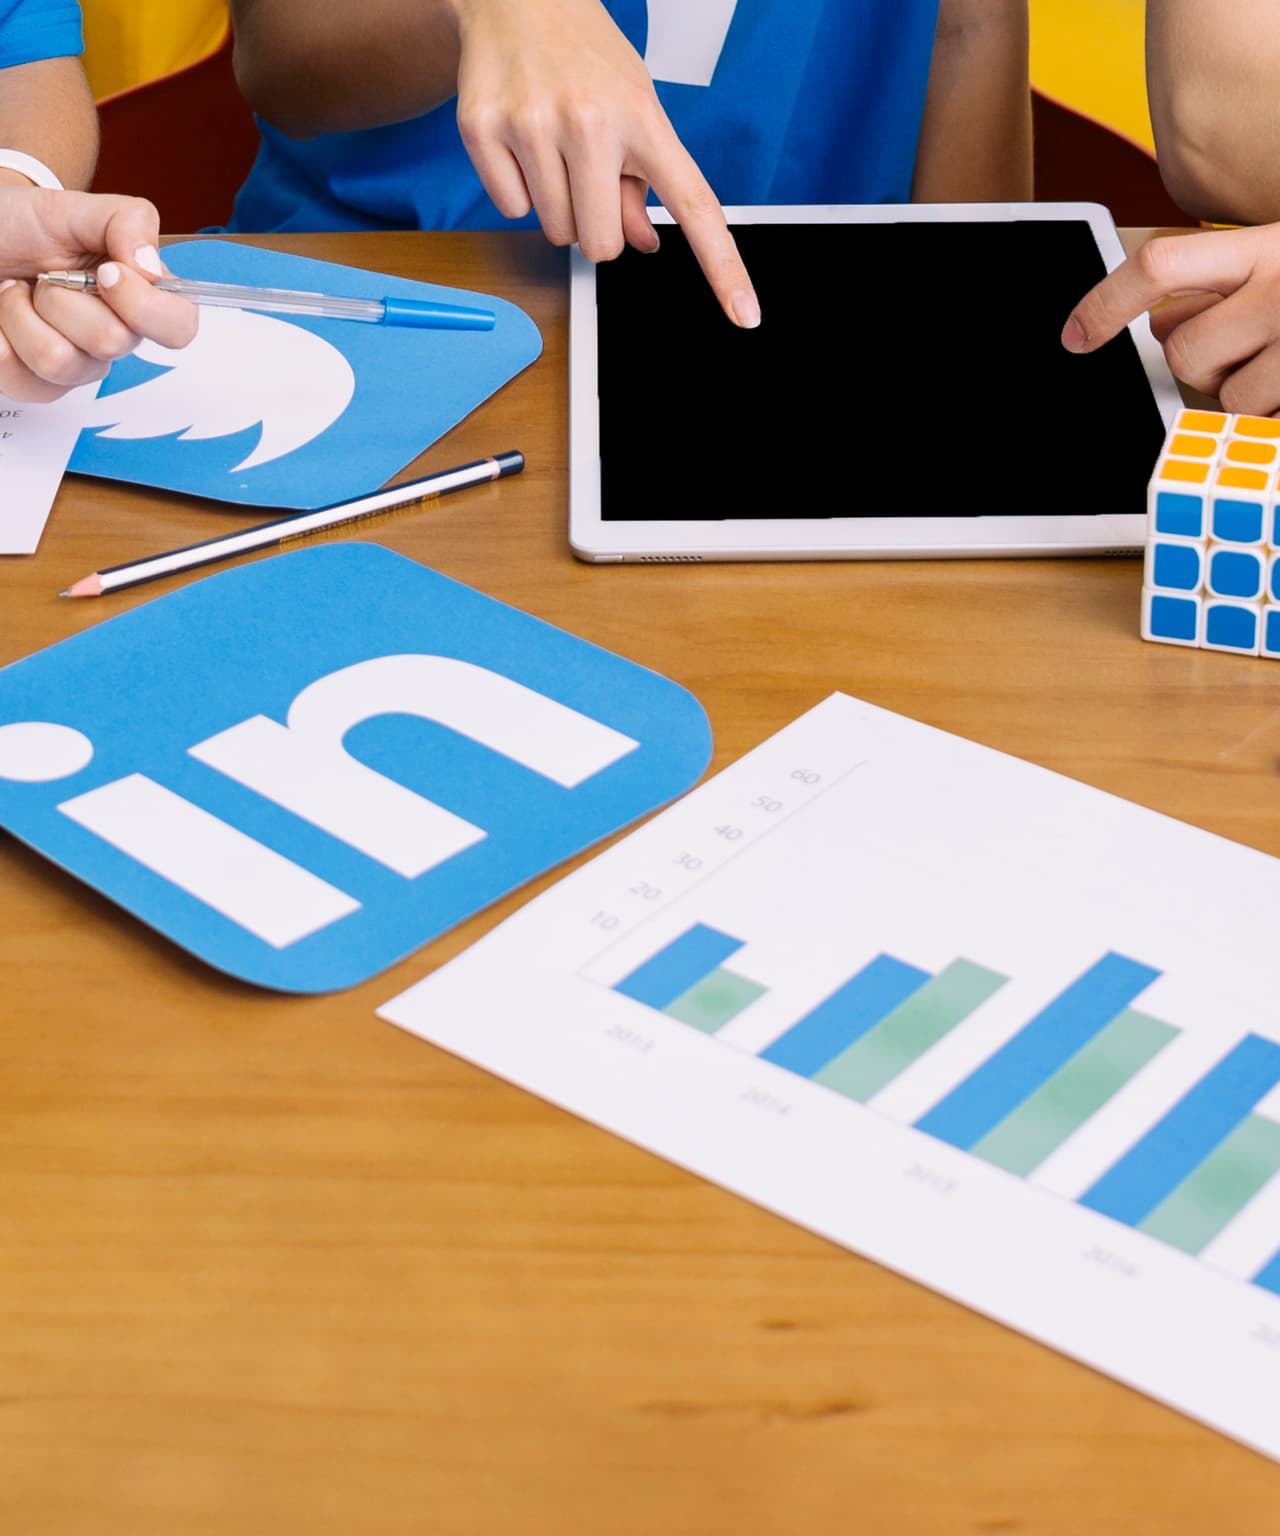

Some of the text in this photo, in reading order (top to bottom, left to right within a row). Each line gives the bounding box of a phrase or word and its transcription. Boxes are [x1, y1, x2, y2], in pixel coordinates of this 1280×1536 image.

[0, 410, 24, 419] 30
[789, 767, 821, 785] 60
[751, 795, 783, 813] 50
[713, 824, 744, 842] 40
[672, 851, 704, 871] 30
[629, 880, 662, 901] 20
[589, 910, 621, 930] 10
